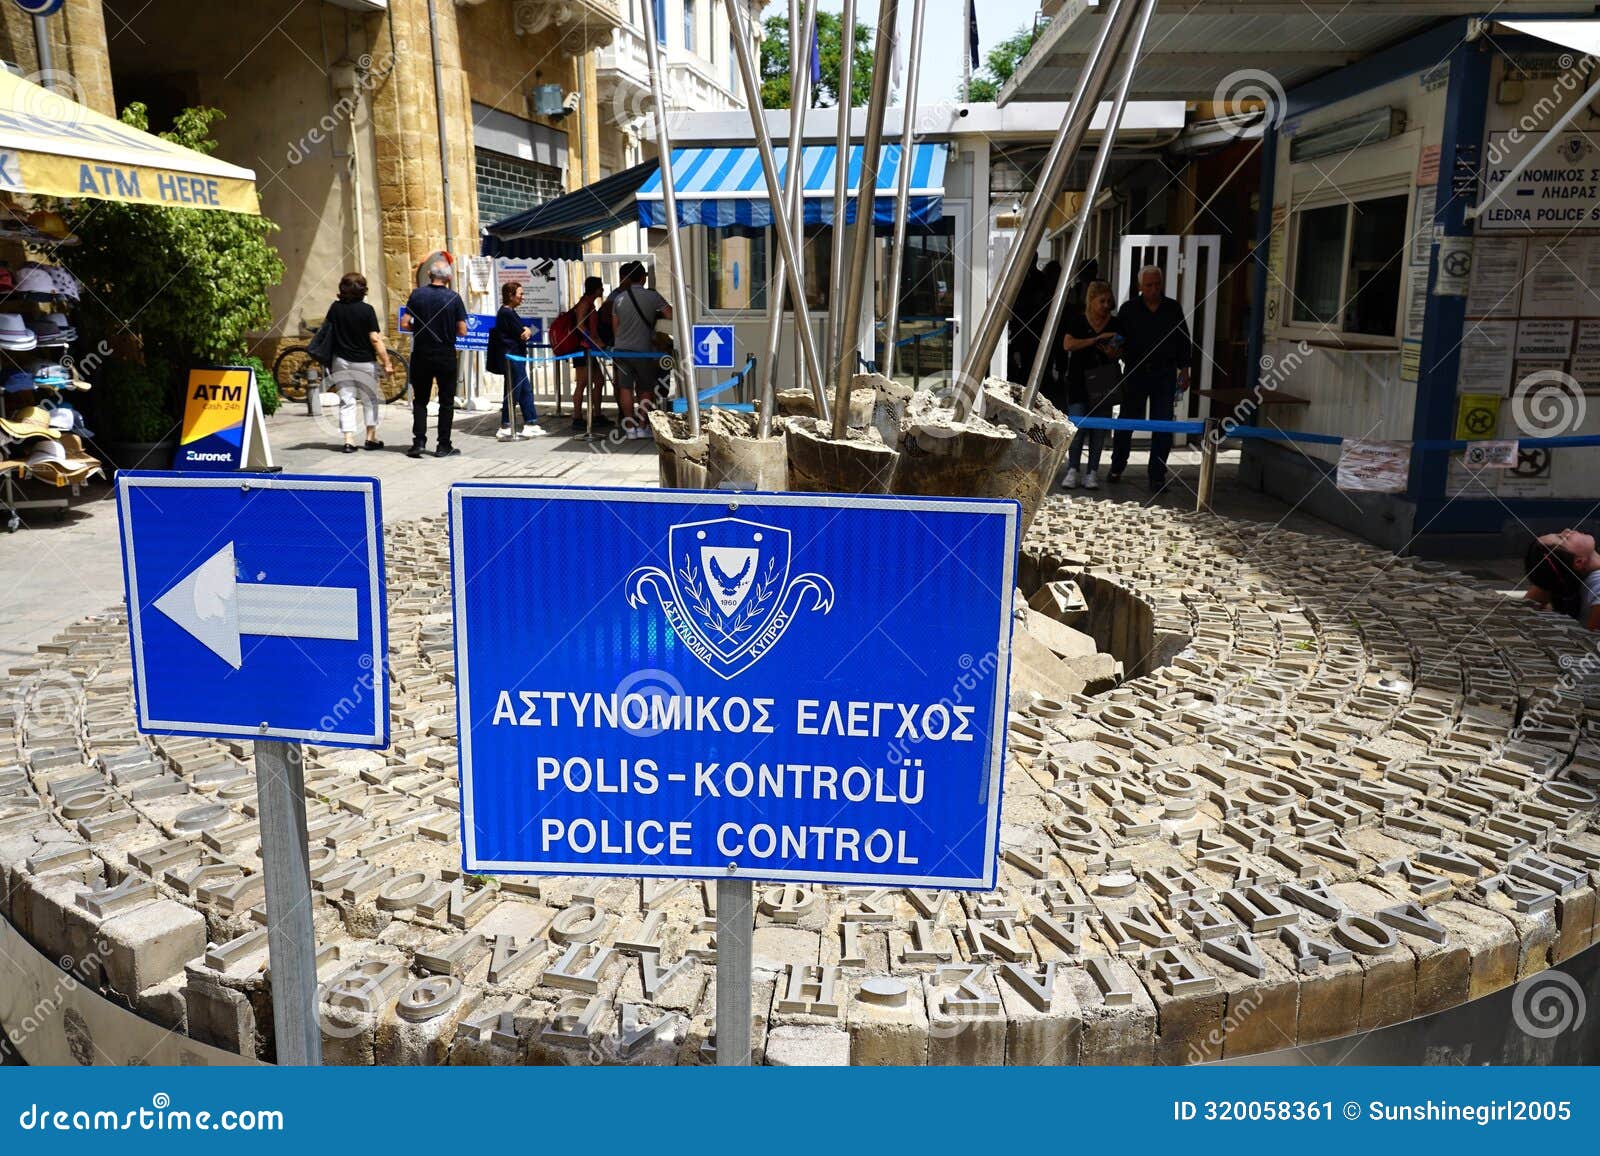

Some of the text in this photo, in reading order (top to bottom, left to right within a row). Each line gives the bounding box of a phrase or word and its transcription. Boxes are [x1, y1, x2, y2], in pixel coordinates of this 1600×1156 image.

[1490, 169, 1585, 183] ΑΣΝΟΜΙΚΟΣ
[79, 164, 221, 206] ATM HERE
[1542, 186, 1598, 199] ΛΗΔΡΑΣ
[1488, 208, 1531, 221] LEDRA
[1537, 208, 1585, 221] POLICE
[193, 384, 242, 402] ATM
[185, 450, 232, 462] Euronet
[720, 599, 738, 607] 1960
[662, 600, 789, 664] ΑΣΤΥΝΟΜΙΑ ΚΥΠΡΟΥ
[492, 690, 976, 742] ΑΣΤΥΝΟΜΙΚΟΣ ΕΛΕΓΧΟΣ
[542, 818, 919, 865] POLICE CONTROL
